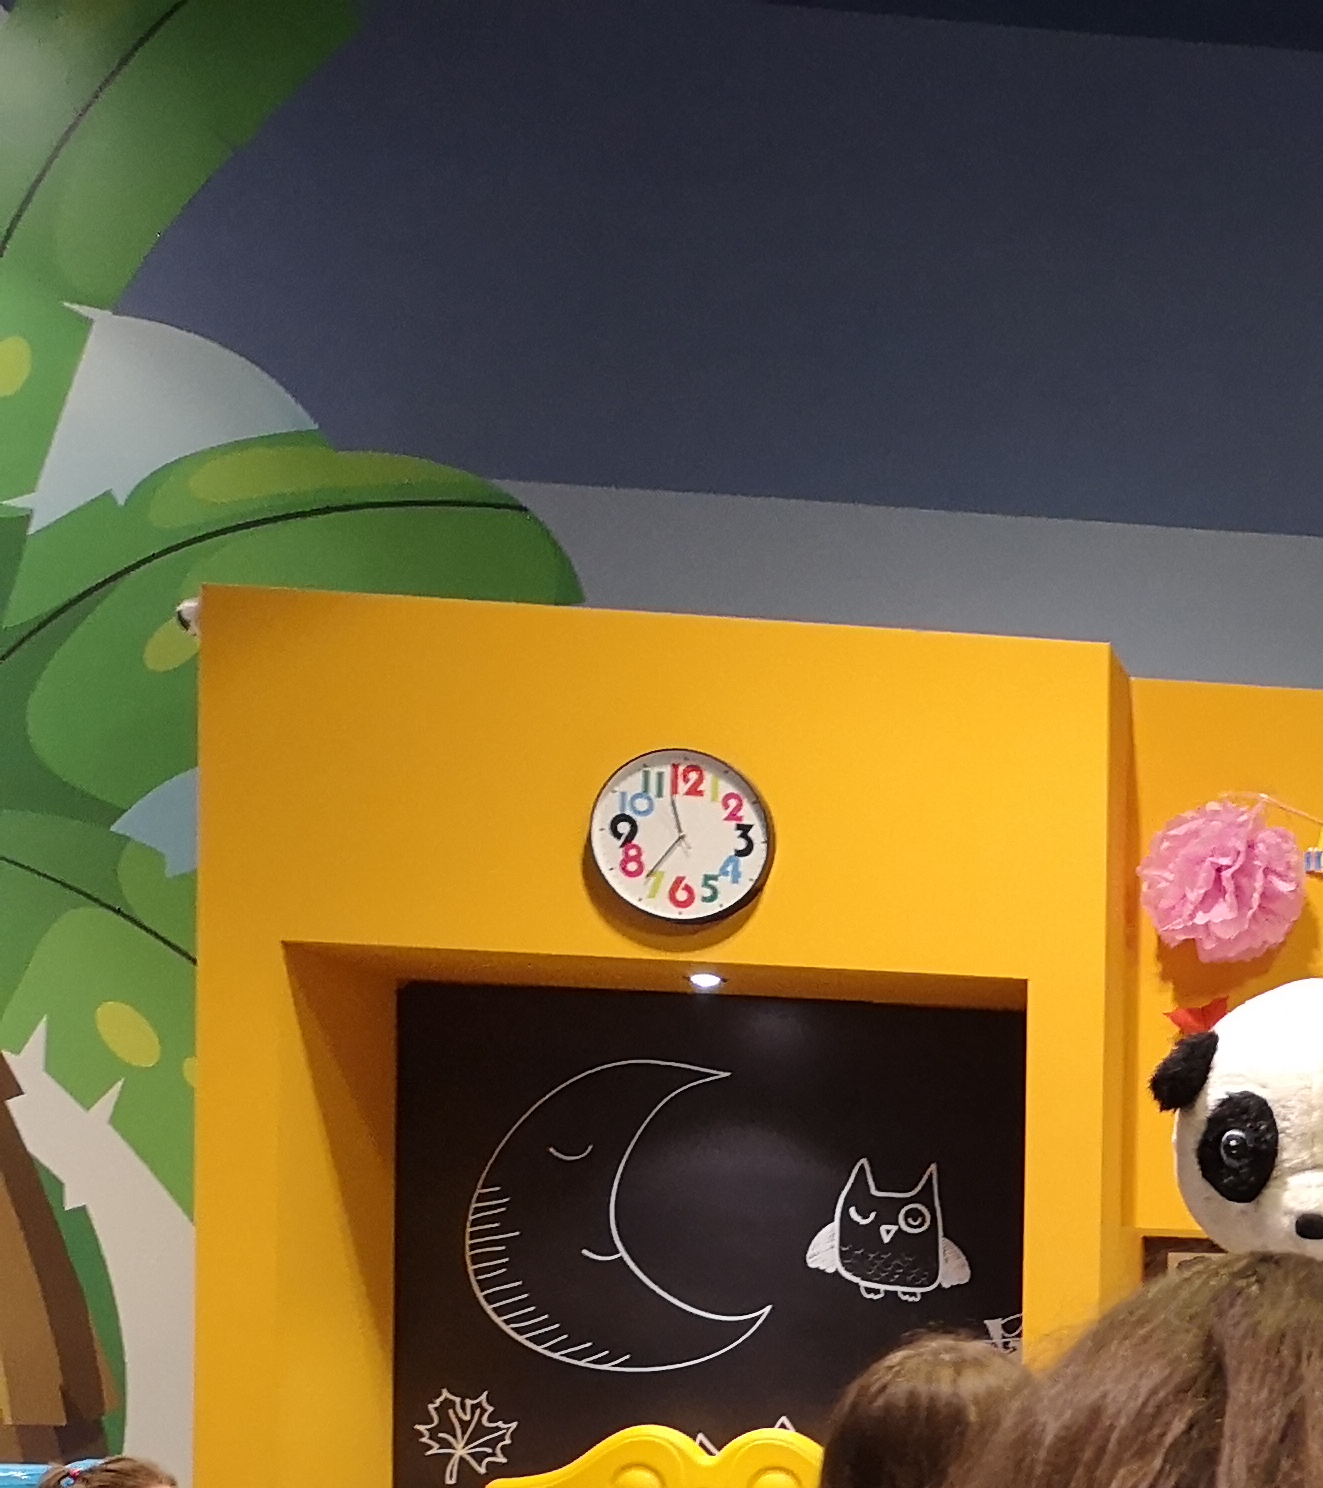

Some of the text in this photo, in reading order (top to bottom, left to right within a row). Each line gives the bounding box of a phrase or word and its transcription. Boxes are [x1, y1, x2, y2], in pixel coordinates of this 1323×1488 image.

[641, 769, 665, 798] 11
[671, 763, 705, 797] 12
[711, 775, 719, 803] 1
[619, 791, 654, 817] 10
[721, 792, 744, 822] 2
[610, 813, 638, 848] 9
[734, 823, 754, 858] 3
[620, 843, 645, 878] 8
[719, 855, 742, 884] 4
[647, 870, 665, 899] 7
[668, 876, 696, 909] 6
[701, 873, 719, 903] 5
